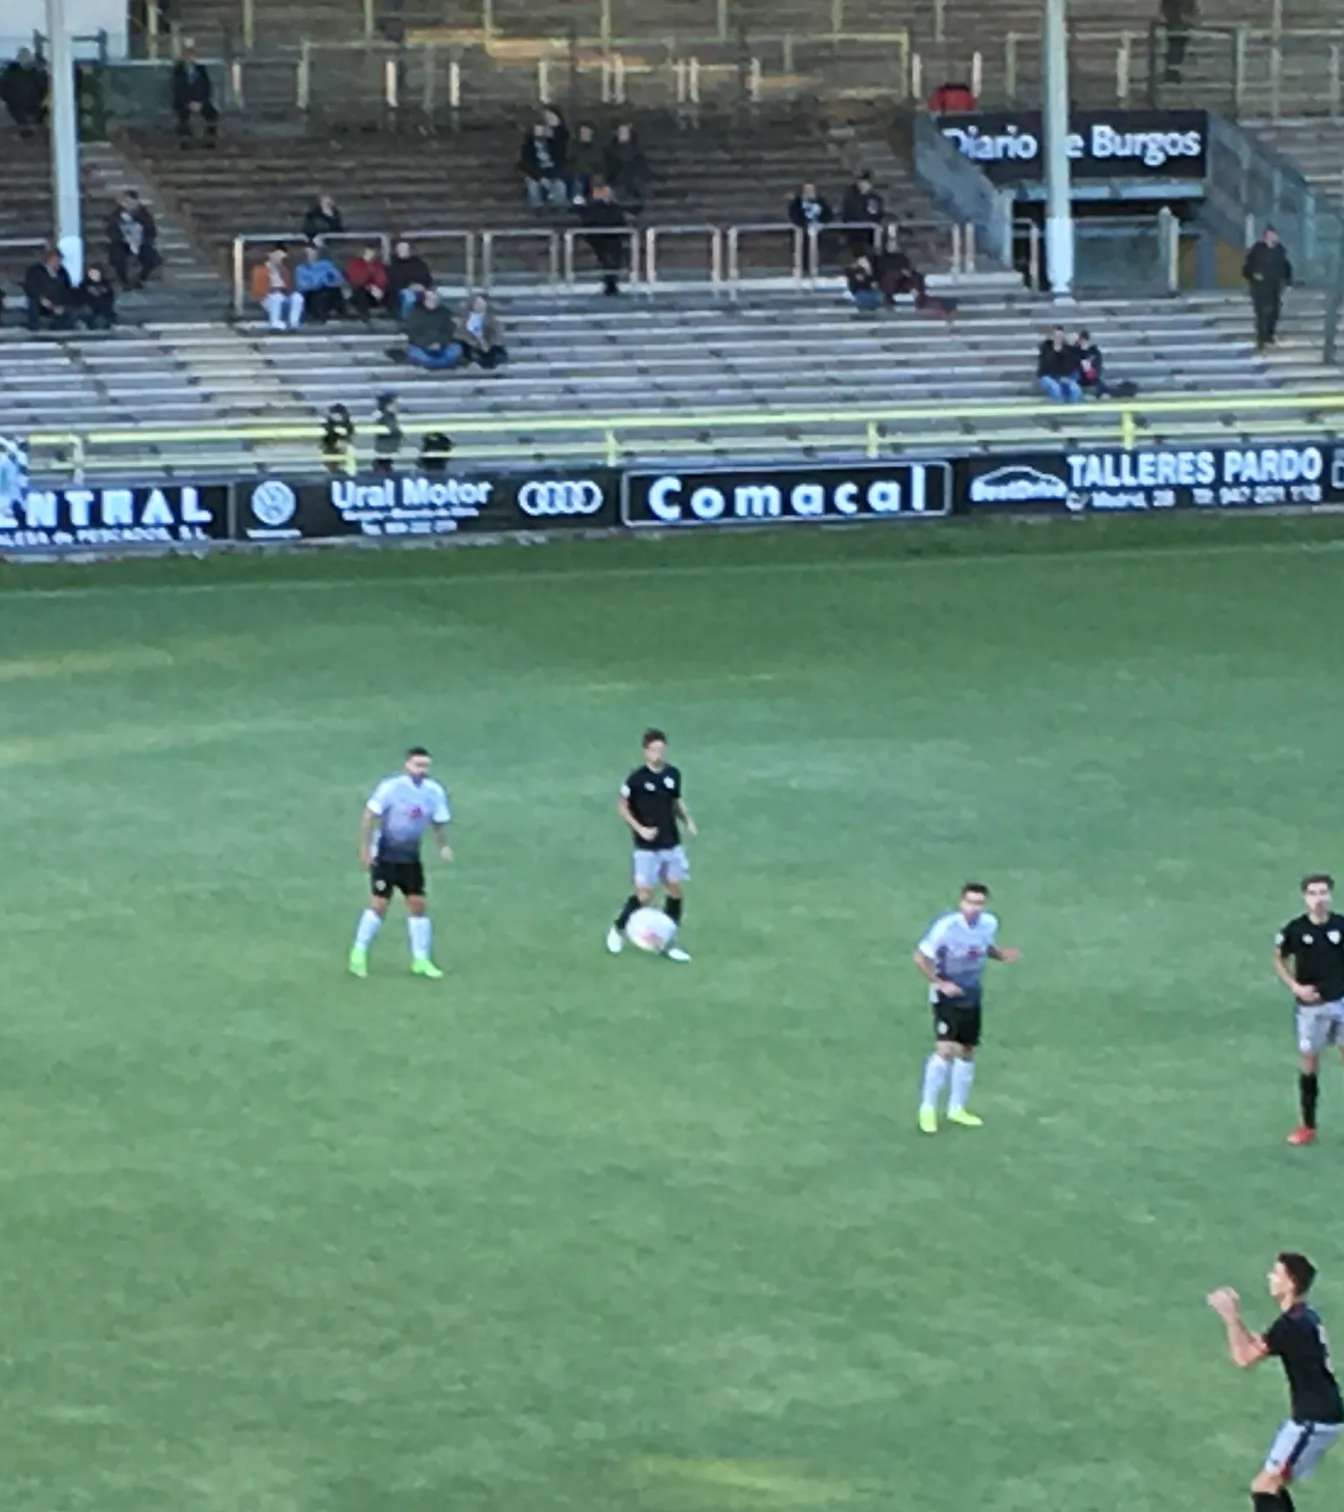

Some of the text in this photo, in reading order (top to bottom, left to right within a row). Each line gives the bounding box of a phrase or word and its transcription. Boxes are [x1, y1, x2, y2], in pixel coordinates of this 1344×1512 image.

[1064, 132, 1084, 157] e
[1092, 124, 1202, 166] Burgos
[1066, 446, 1323, 487] TALLERES PARDO
[331, 477, 494, 508] Ural Motor
[648, 464, 926, 521] Comacal
